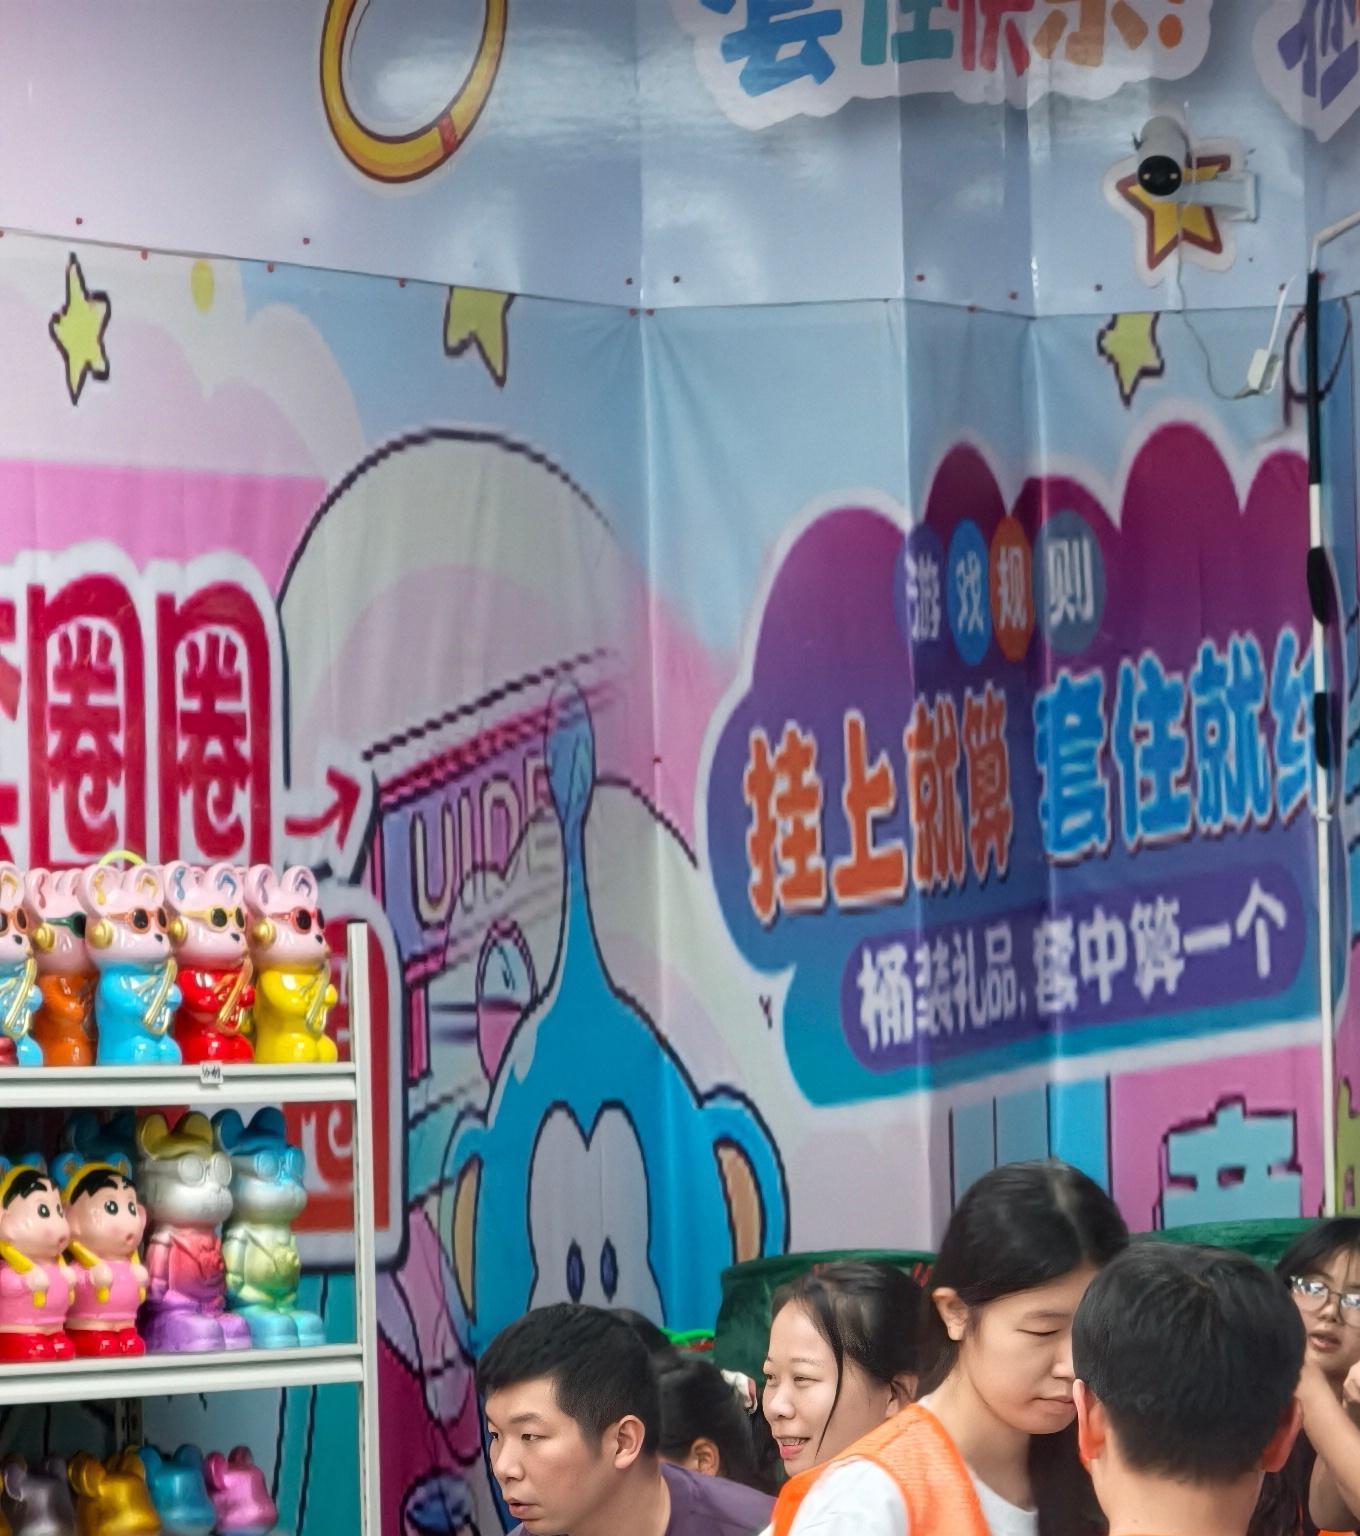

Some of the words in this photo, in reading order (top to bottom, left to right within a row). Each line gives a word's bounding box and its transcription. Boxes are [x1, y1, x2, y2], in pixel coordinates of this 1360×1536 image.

[905, 534, 1094, 642] 游戏规则
[0, 573, 271, 868] 圈圈
[743, 681, 1014, 923] 挂上就算
